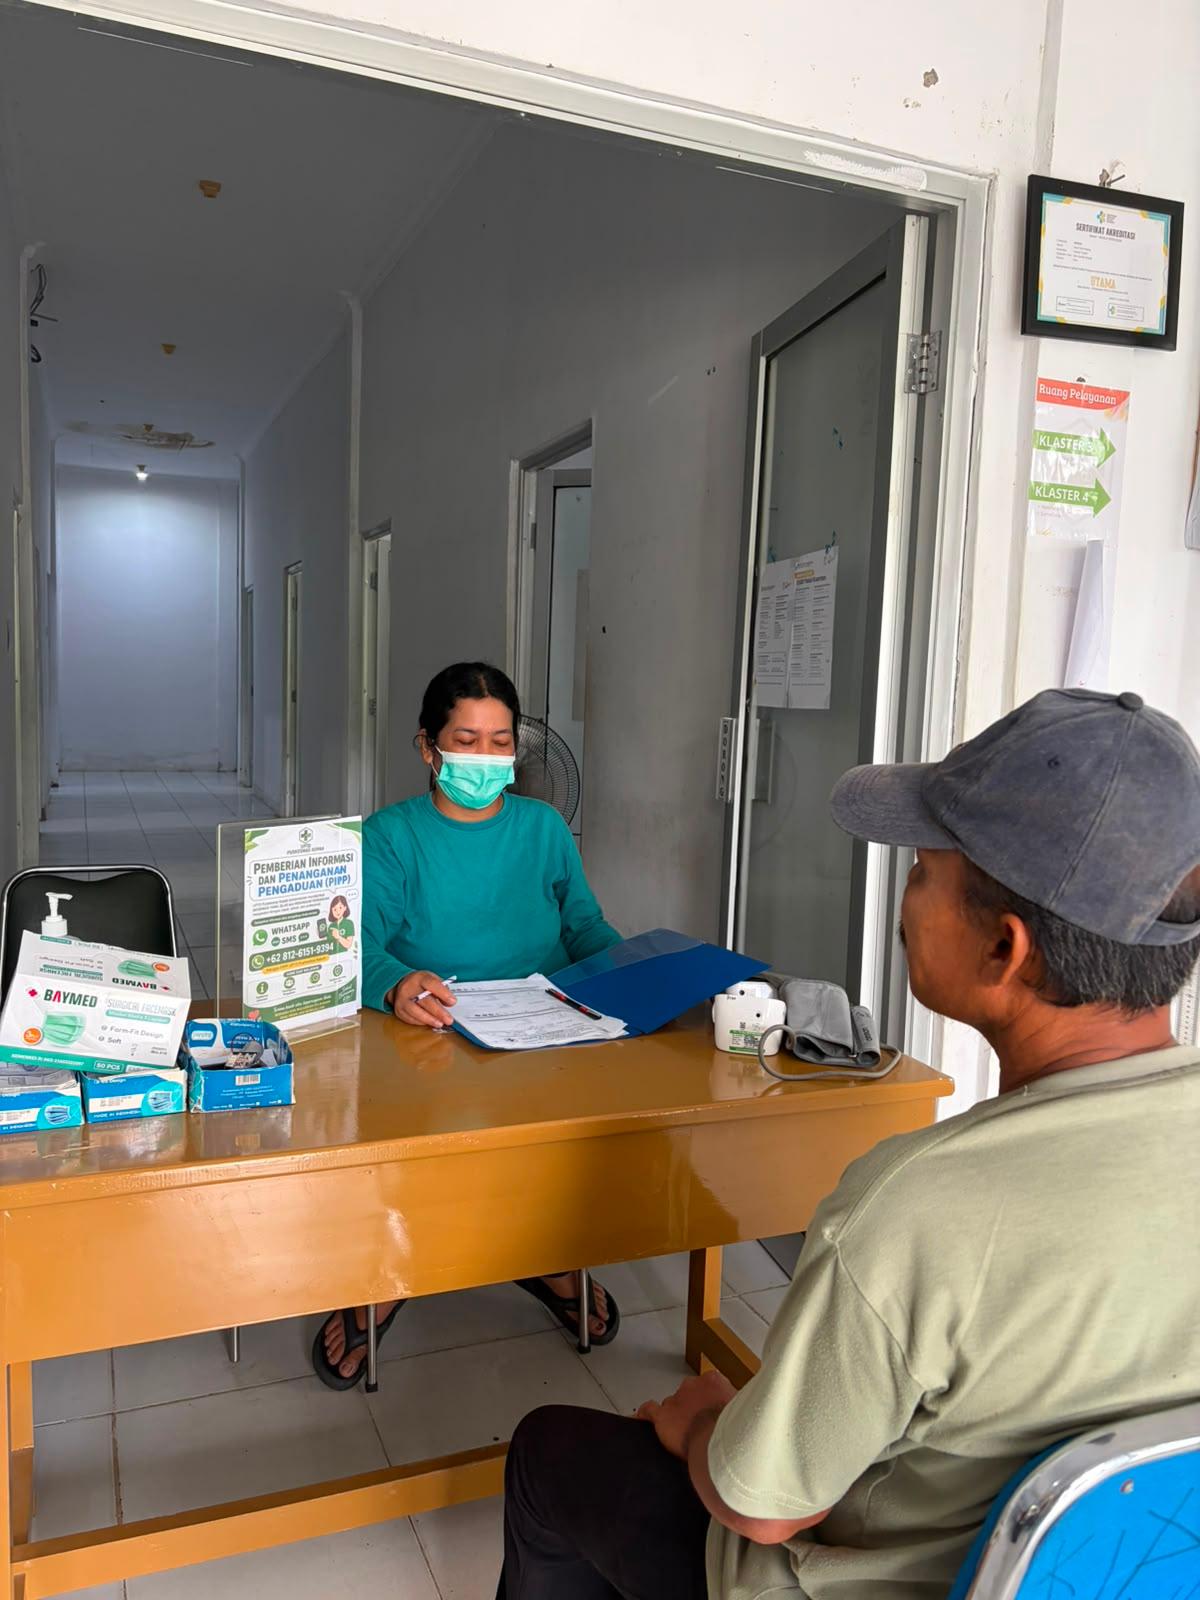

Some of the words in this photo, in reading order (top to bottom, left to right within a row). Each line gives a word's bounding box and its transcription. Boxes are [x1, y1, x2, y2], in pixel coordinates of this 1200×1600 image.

[1076, 222, 1106, 235] SERTIFIKAT
[1106, 227, 1136, 240] AKREDITASI
[1090, 275, 1116, 289] UTAMA
[1039, 383, 1069, 400] Ruang
[1070, 388, 1117, 405] Pelayanan
[1040, 435, 1084, 451] KLASTER
[1035, 486, 1080, 501] KLASTER
[1082, 492, 1089, 502] 4
[253, 859, 306, 875] PEMBERIAN
[308, 852, 354, 868] INFORMASI
[258, 875, 276, 885] DAN
[278, 865, 347, 883] PENANGANAN
[258, 879, 323, 897] PENGADUAN
[325, 874, 351, 888] (PIPP)
[271, 922, 310, 935] WHATSAPP
[281, 935, 297, 945] SMS
[266, 953, 281, 963] +62
[282, 942, 334, 960] 812-6151-9394
[112, 977, 157, 990] BAYMED
[44, 989, 98, 1008] BAYMED
[107, 1036, 122, 1045] Soft
[109, 1025, 139, 1037] Form-Fit
[140, 1030, 164, 1040] Design
[106, 1063, 121, 1071] PCS
